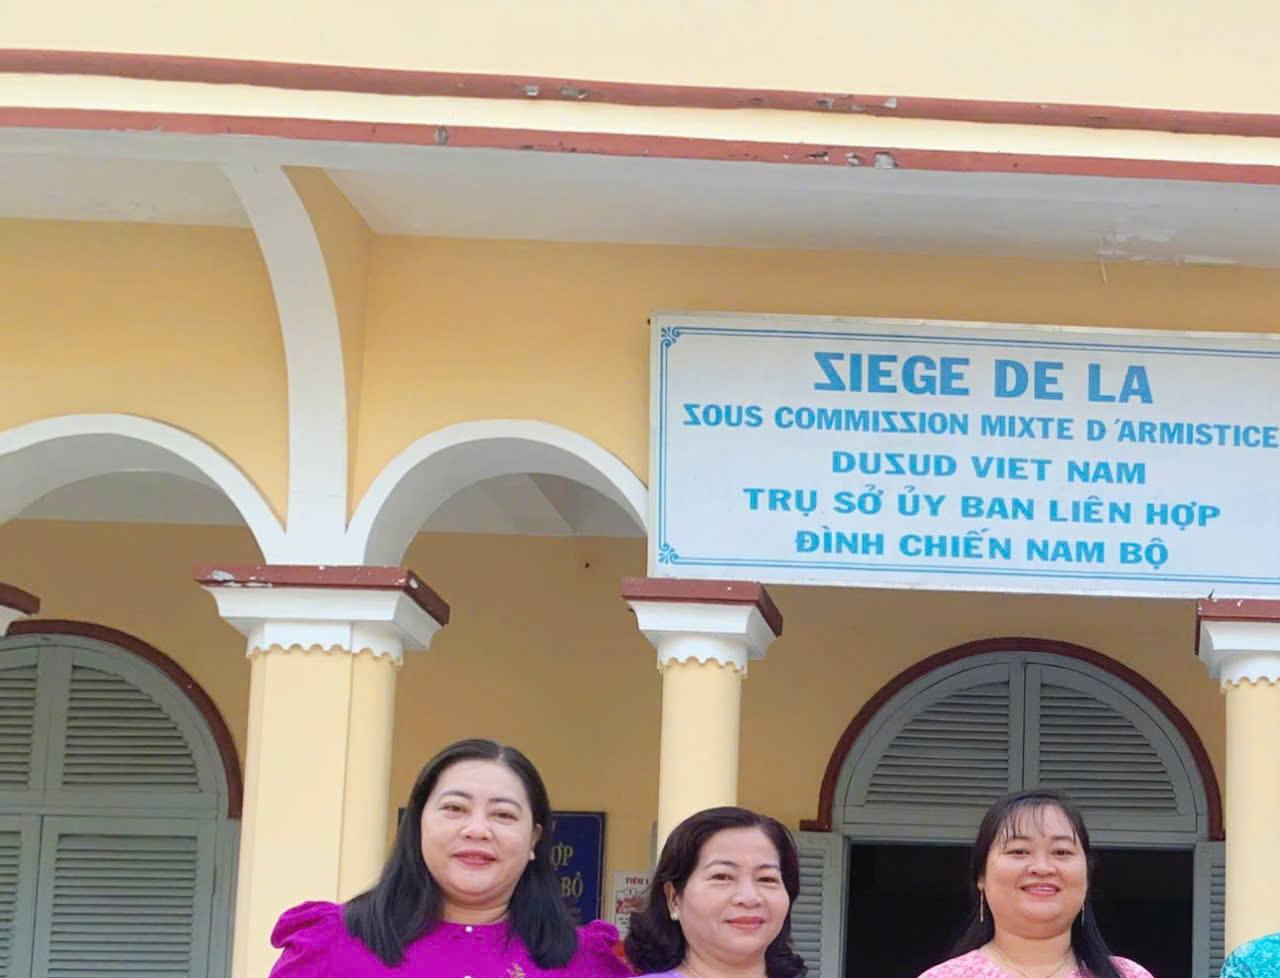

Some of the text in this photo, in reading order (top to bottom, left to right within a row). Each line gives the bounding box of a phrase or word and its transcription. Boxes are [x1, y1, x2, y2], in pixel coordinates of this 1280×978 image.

[994, 359, 1064, 401] DE
[1088, 363, 1154, 404] LA
[980, 414, 1074, 440] MIXTE
[971, 456, 1052, 482] VIET
[1067, 460, 1146, 484] NAM
[743, 483, 1220, 531] TRỤ SỞ ỦY BAN LIÊN HỢP
[795, 525, 1168, 570] ĐÌNH CHIẾN NAM BỘ
